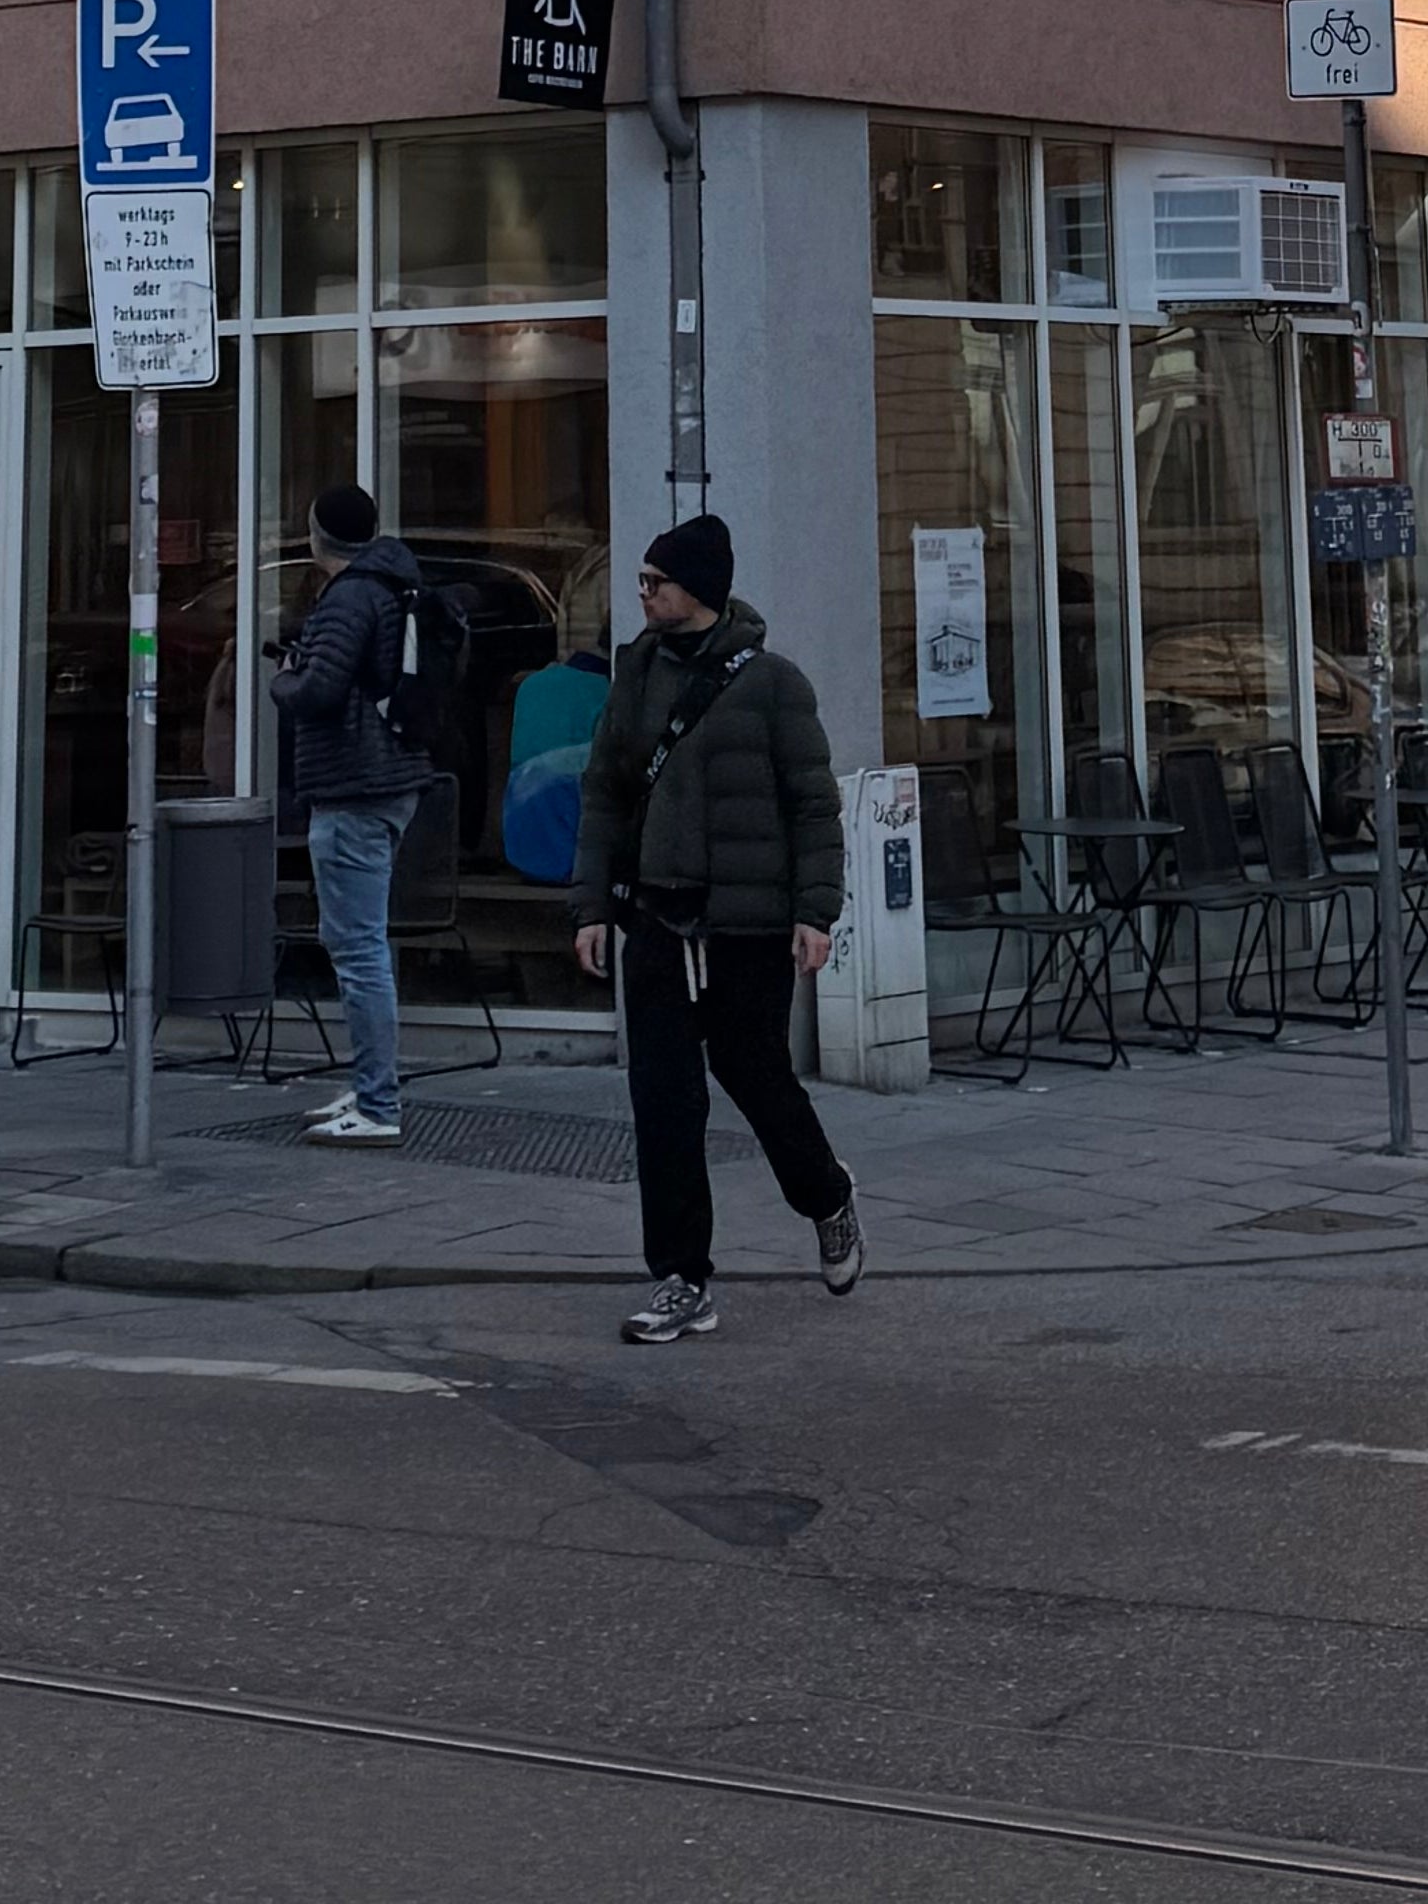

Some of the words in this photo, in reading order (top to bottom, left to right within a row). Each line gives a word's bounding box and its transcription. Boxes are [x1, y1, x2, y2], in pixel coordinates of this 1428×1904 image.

[511, 36, 545, 68] THE
[553, 41, 598, 74] BARN
[1326, 63, 1359, 84] frei
[118, 206, 176, 226] werktags
[104, 259, 121, 272] mit
[126, 255, 195, 272] Parkschein
[133, 280, 161, 296] oder
[113, 305, 187, 321] Parkauswe
